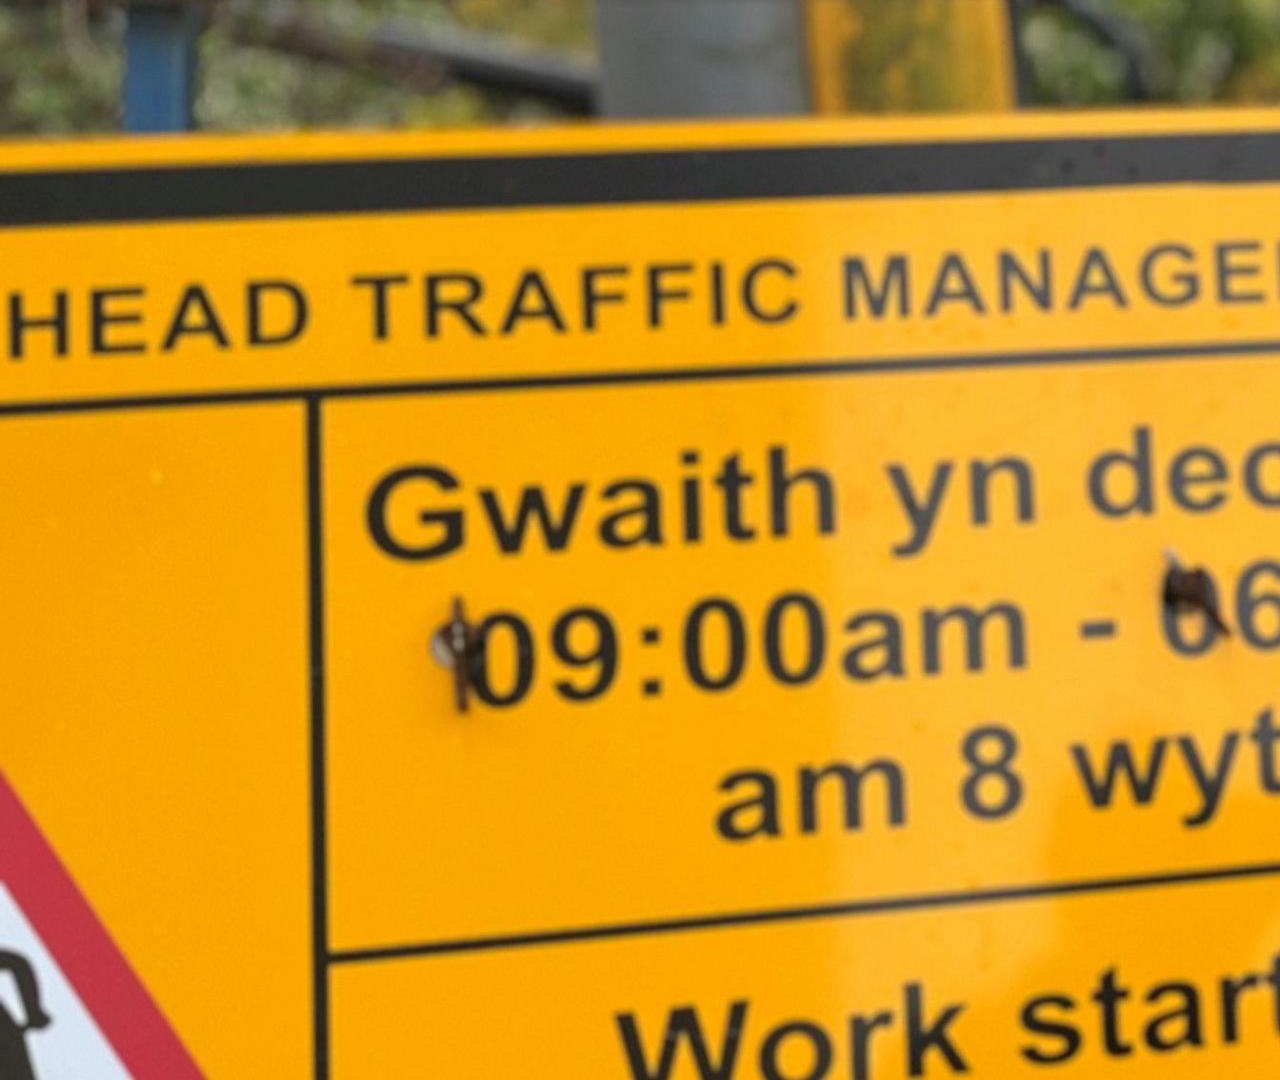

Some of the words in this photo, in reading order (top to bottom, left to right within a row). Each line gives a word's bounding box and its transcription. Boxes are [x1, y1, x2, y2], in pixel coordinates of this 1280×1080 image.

[351, 258, 799, 341] TRAFFIC
[363, 444, 837, 564] Gwaith
[886, 457, 1036, 559] yn
[473, 590, 1028, 708] 09:00am
[714, 758, 907, 844] am
[960, 724, 1024, 821] 8
[614, 981, 971, 1080] Work
